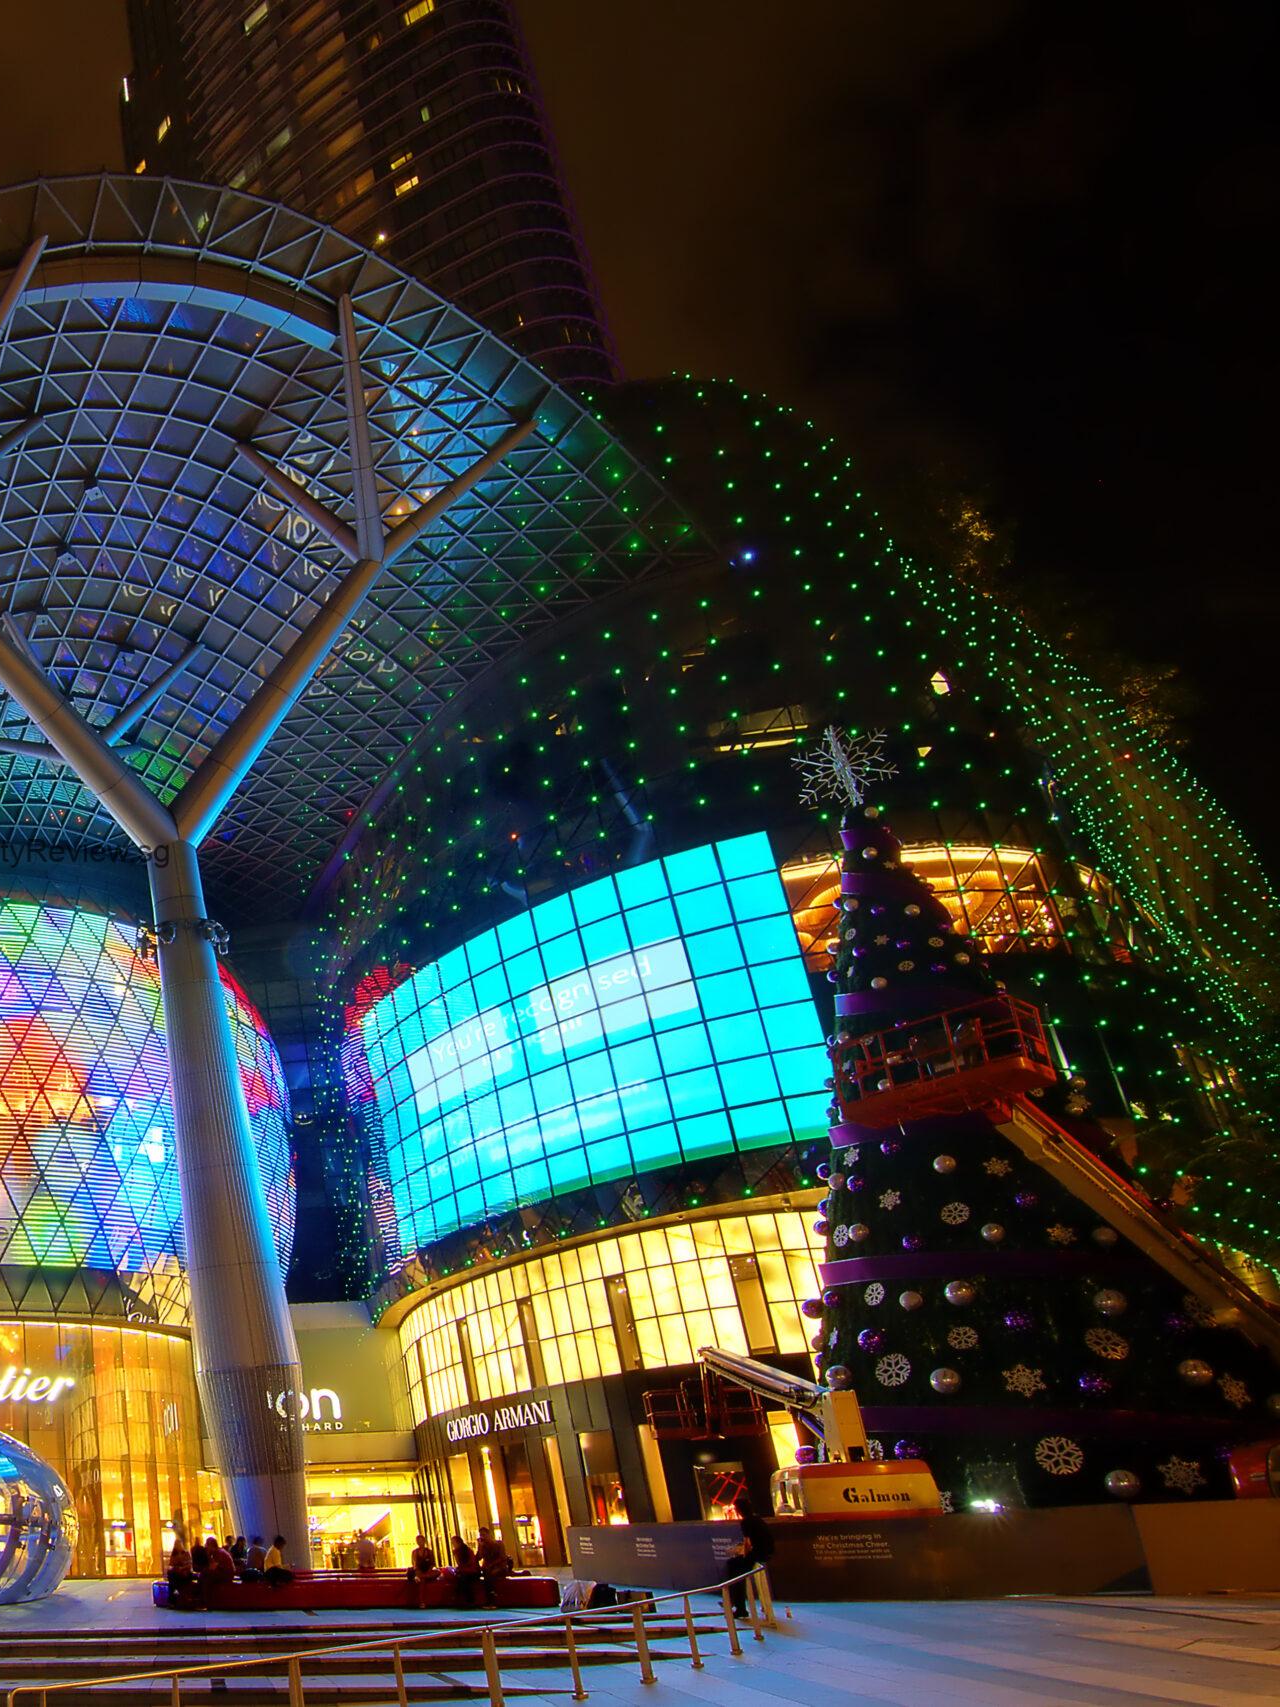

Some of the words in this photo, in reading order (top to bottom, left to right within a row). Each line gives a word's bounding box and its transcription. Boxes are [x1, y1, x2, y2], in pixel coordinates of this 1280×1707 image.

[432, 1021, 497, 1062] You're
[446, 1412, 489, 1442] GIORGIO
[494, 1400, 551, 1432] ARMANI
[842, 1487, 911, 1503] Galmon
[840, 1533, 872, 1541] bringing
